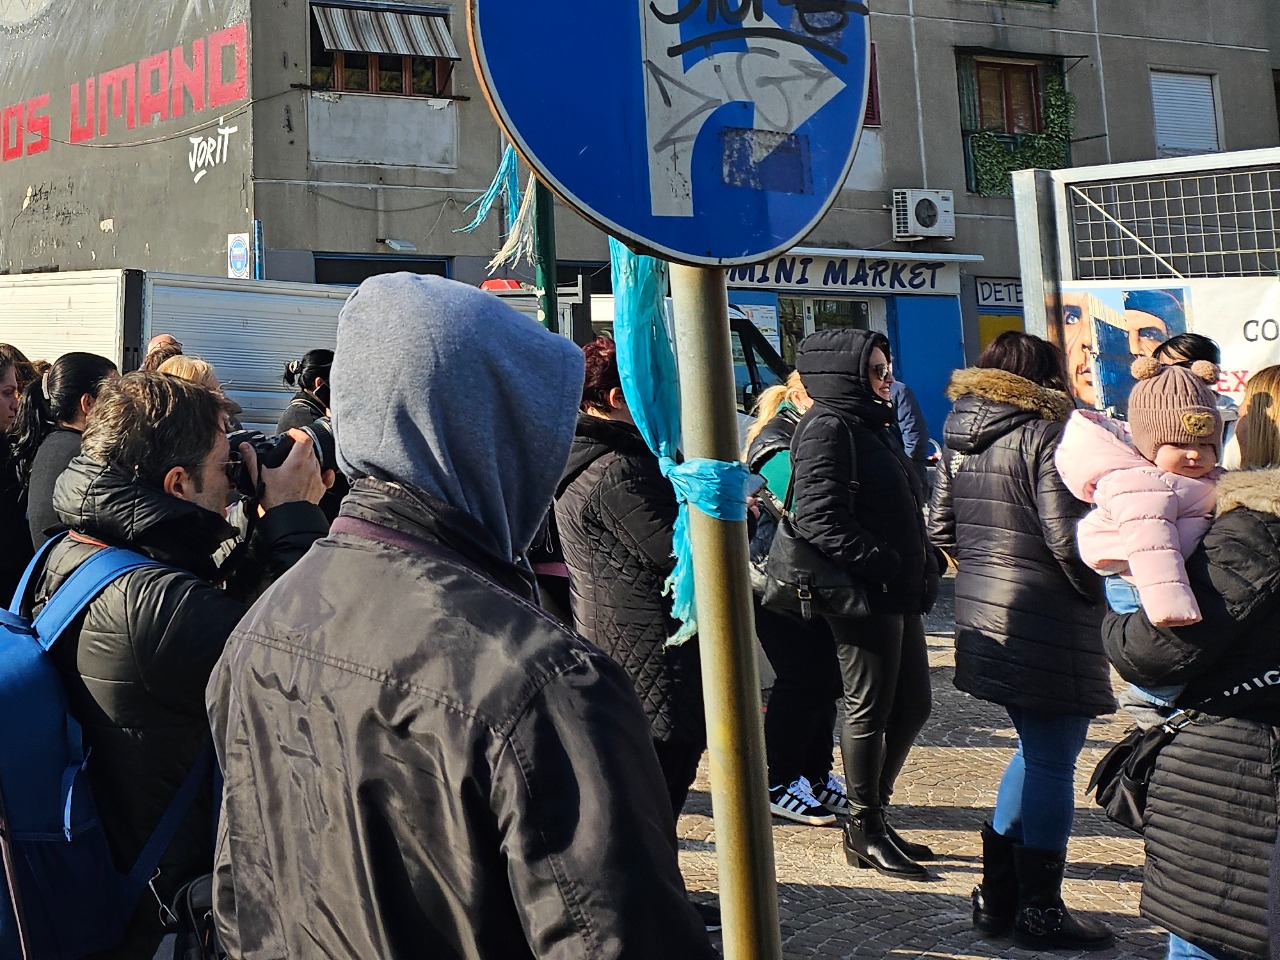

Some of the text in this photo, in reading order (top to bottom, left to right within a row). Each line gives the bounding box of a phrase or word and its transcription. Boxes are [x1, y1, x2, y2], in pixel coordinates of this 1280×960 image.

[70, 22, 248, 145] UMANO
[188, 116, 238, 173] JORIT
[729, 256, 947, 290] MINI MARKET
